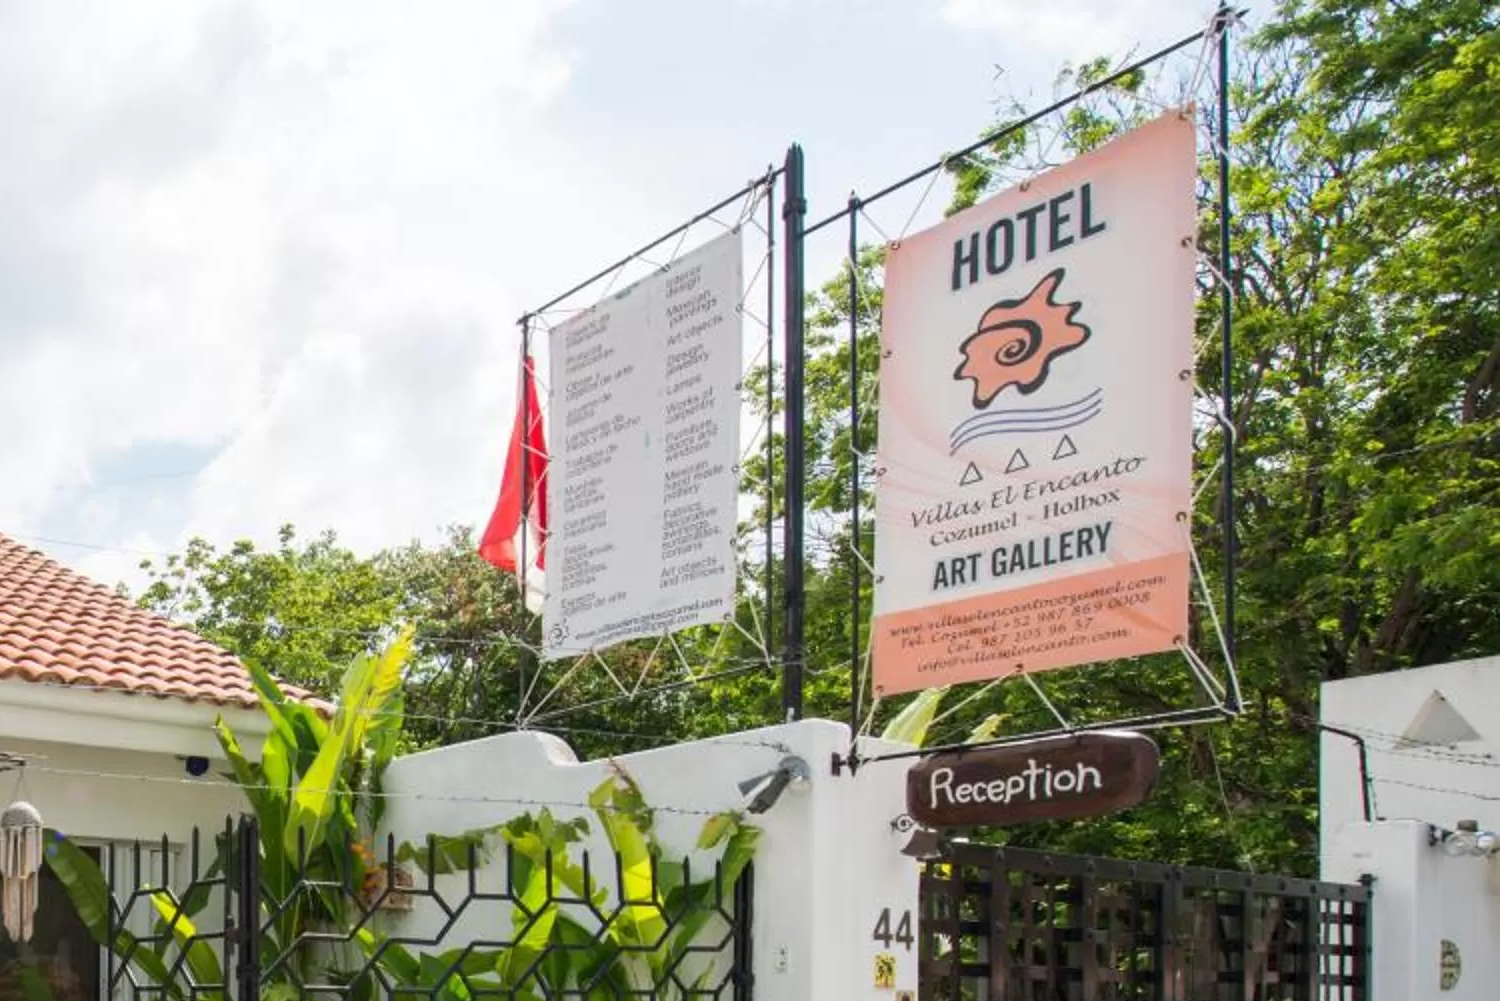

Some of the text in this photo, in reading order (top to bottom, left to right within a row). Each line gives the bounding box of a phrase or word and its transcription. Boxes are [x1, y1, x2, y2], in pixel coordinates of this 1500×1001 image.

[951, 184, 1105, 291] HOTEL
[911, 457, 1144, 528] Villas El Encanto
[930, 512, 1017, 547] Cozumel
[1043, 490, 1120, 520] Holbox
[933, 521, 1111, 590] ART GALLERY
[929, 758, 1103, 810] Reception
[872, 907, 915, 952] 44
